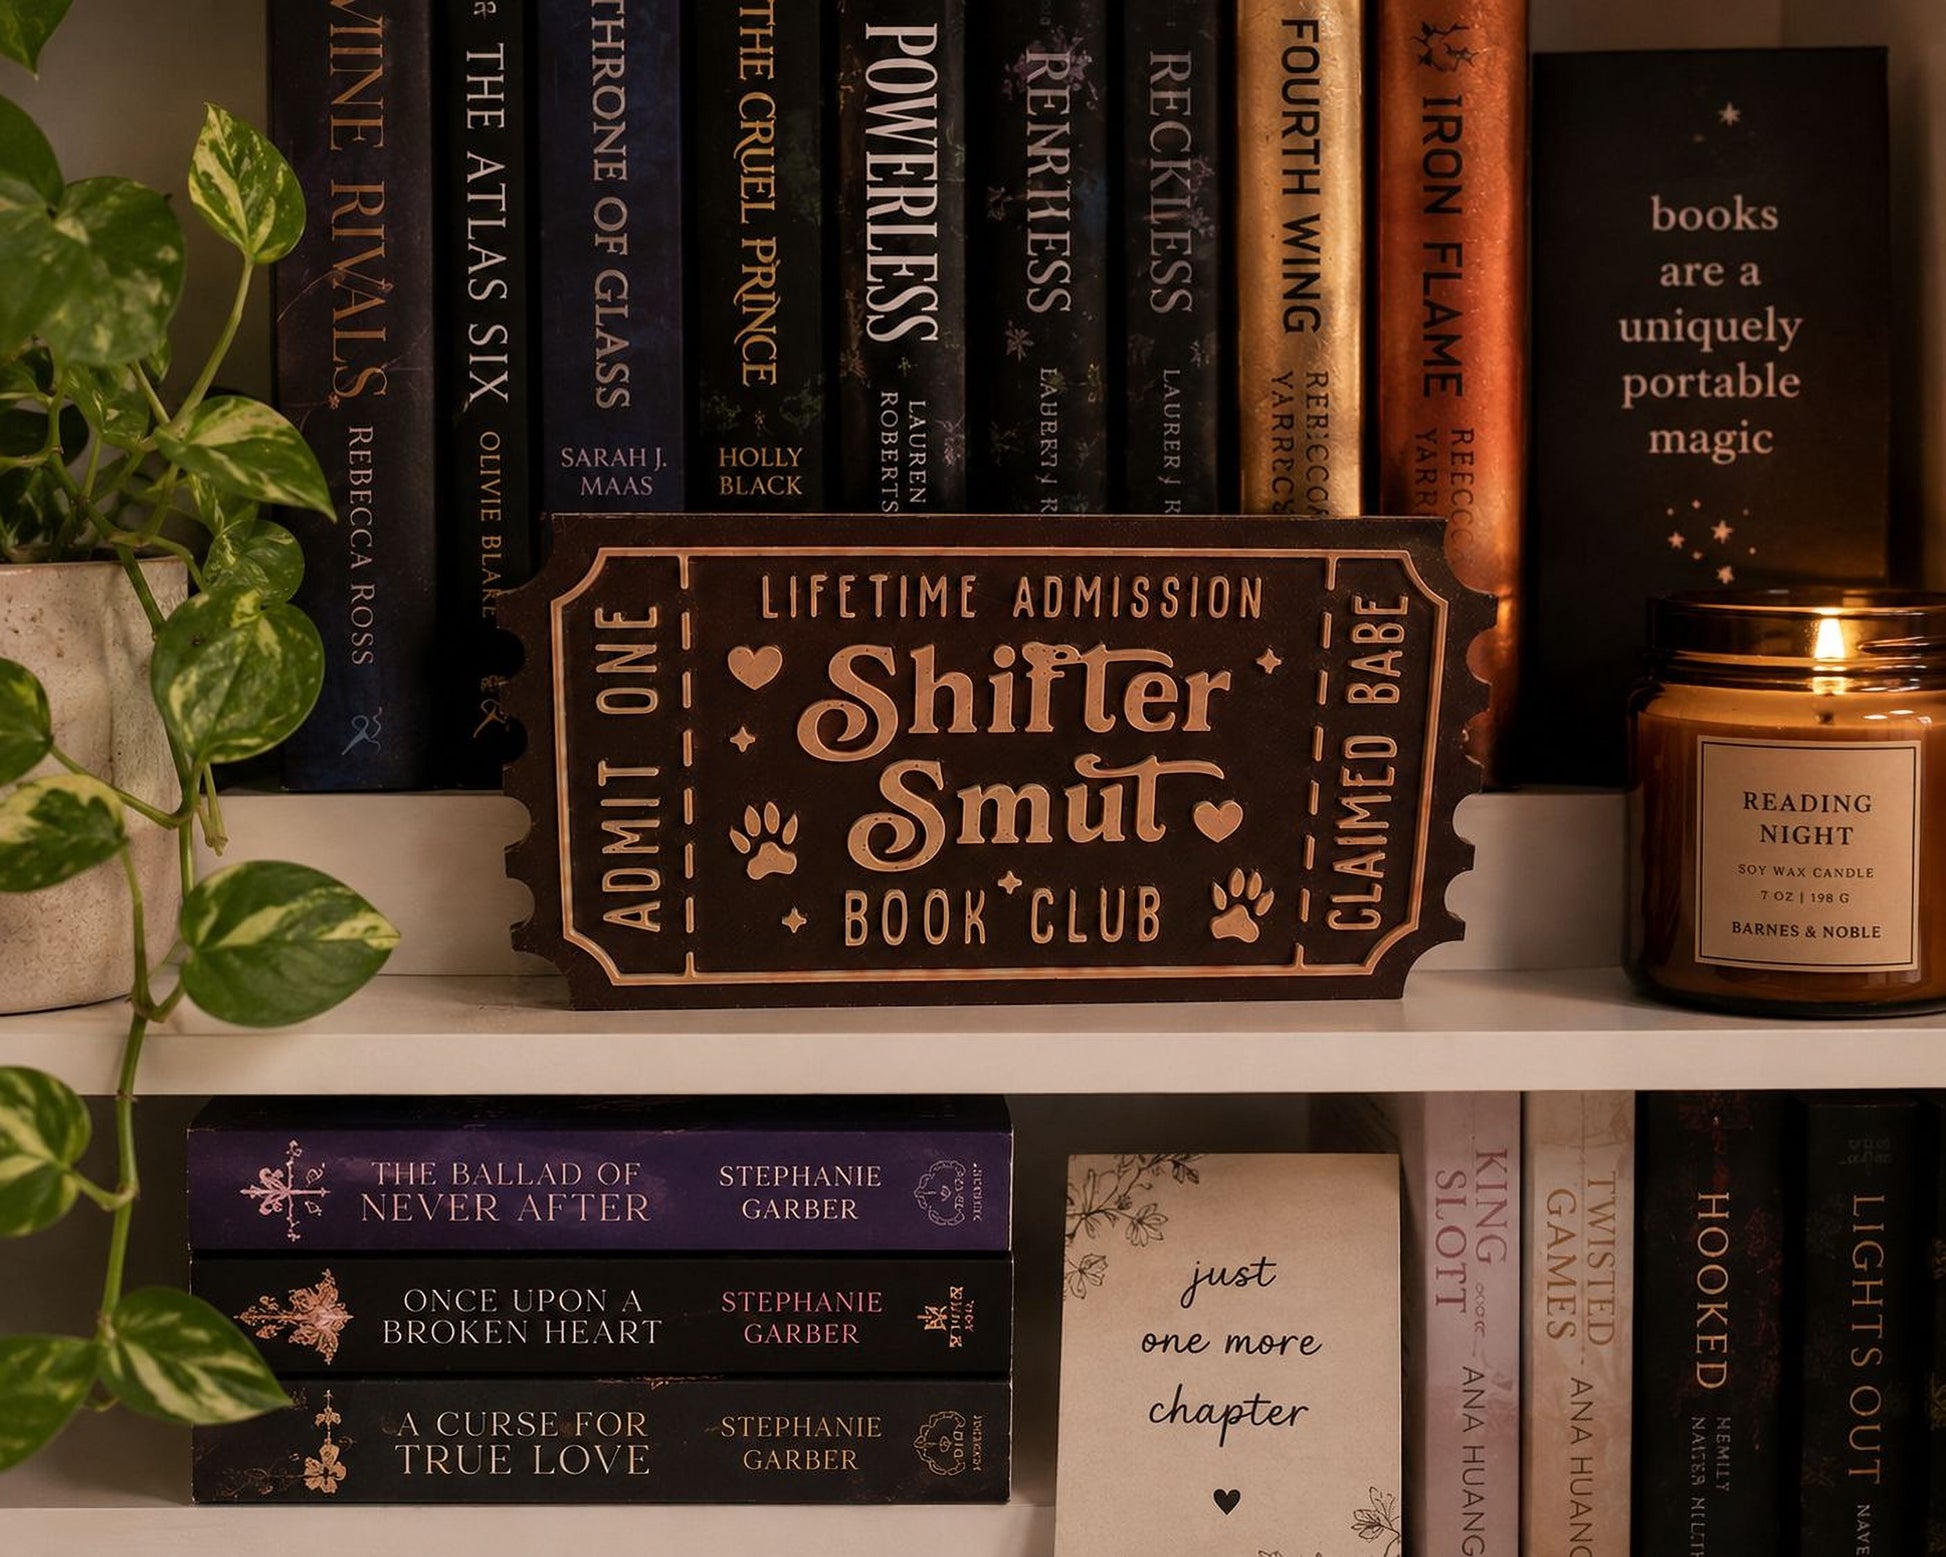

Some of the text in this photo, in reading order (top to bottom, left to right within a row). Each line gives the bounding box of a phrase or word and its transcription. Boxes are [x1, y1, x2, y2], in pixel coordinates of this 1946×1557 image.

[733, 0, 780, 387] THE CRUEL PRINCE
[865, 22, 939, 343] POWERLESS
[1148, 50, 1194, 315] RECKLESS
[1281, 18, 1322, 336] FOURTH WING
[466, 43, 509, 403] THE ATLAS SIX
[592, 0, 631, 409] THRONE OF GLASS
[1651, 196, 1780, 231] books
[1422, 94, 1464, 398] IRON FLAME
[330, 179, 388, 399] RIVALS
[1660, 260, 1762, 287] are a
[1618, 306, 1803, 353] uniquely
[1621, 362, 1801, 409] portable
[560, 447, 668, 471] SARAH J.
[719, 446, 803, 468] HOLLY
[880, 390, 899, 513] ROBERTS
[908, 399, 927, 504] LAUREN
[1648, 420, 1774, 465] magic
[480, 430, 502, 523] OLIVIE
[579, 475, 654, 497] MAAS
[719, 475, 803, 496] BLACK
[348, 426, 376, 665] REBECCA ROSS
[761, 574, 1263, 620] LIFETIME ADMISSION
[797, 641, 1231, 763] Shifter
[595, 605, 661, 933] ADMIT ONE
[1325, 594, 1409, 932] CLAIMED BABE
[847, 752, 1225, 872] Smut
[1743, 791, 1873, 814] READING
[1759, 823, 1855, 846] NIGHT
[1738, 863, 1875, 879] SOY WAX CANDLE
[844, 885, 1162, 946] BOOK CLUB
[1760, 890, 1768, 901] 7
[1774, 890, 1794, 902] OZ
[1810, 892, 1834, 904] 198
[1839, 892, 1850, 904] G
[1731, 920, 1882, 940] BARNES & NOBLE
[371, 1162, 642, 1186] THE BALLAD OF
[718, 1165, 882, 1188] STEPHANIE
[360, 1193, 653, 1222] NEVER AFTER
[741, 1198, 860, 1221] GARBER
[1475, 1148, 1508, 1265] KING
[1545, 1187, 1578, 1340] GAMES
[1587, 1170, 1617, 1347] TWISTED
[1850, 1194, 1886, 1368] LIGHTS
[403, 1288, 644, 1313] ONCE UPON A
[721, 1291, 884, 1314] STEPHANIE
[1179, 1255, 1278, 1310] just
[1695, 1191, 1731, 1390] HOOKED
[382, 1319, 663, 1345] BROKEN HEART
[743, 1323, 861, 1346] GARBER
[1140, 1331, 1324, 1356] one more
[396, 1410, 649, 1437] A CURSE FOR
[720, 1415, 884, 1439] STEPHANIE
[1148, 1383, 1310, 1448] chapter
[1570, 1376, 1594, 1446] ANA
[1848, 1385, 1883, 1485] OUT
[394, 1444, 650, 1475] TRUE LOVE
[743, 1449, 861, 1472] GARBER
[1461, 1366, 1486, 1557] ANA HUANG
